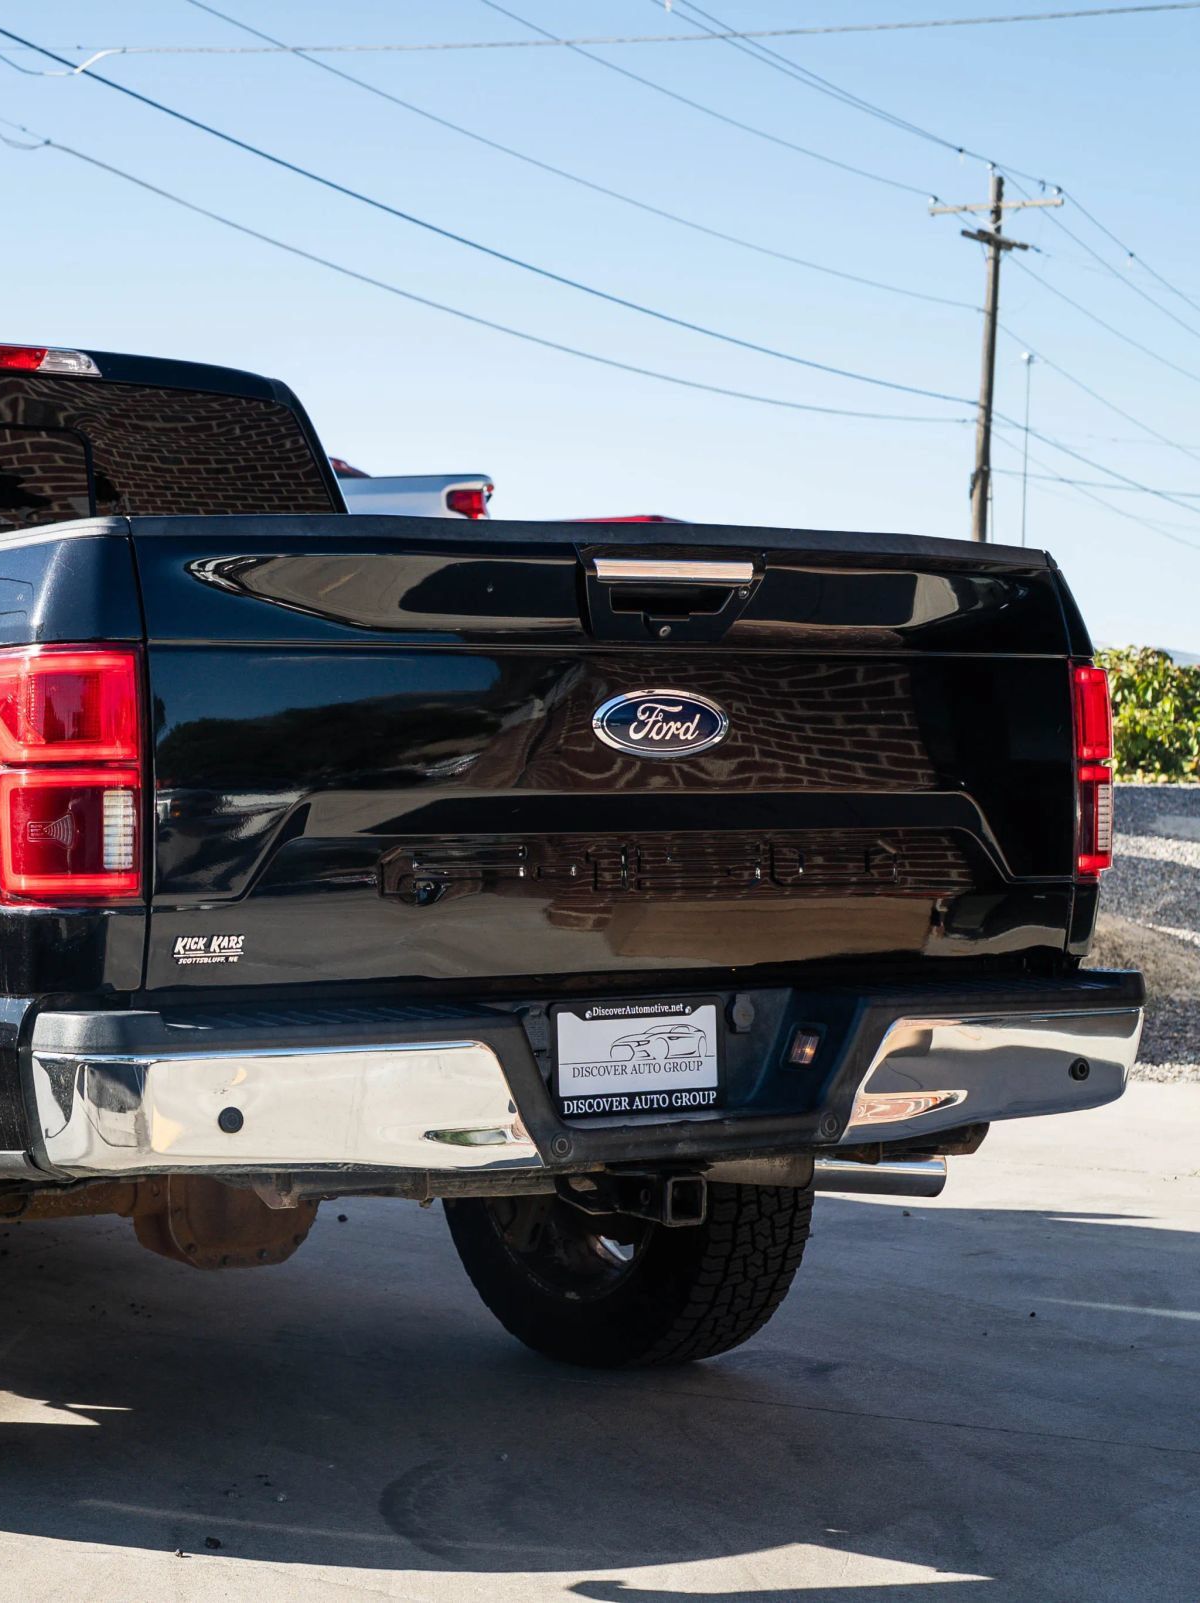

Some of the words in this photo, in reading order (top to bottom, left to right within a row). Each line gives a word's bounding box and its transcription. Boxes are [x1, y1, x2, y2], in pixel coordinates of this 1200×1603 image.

[629, 703, 700, 740] Ford
[174, 937, 207, 955] KICK
[210, 935, 245, 953] KARS
[228, 955, 239, 963] NE
[592, 1003, 684, 1017] DiscoverAutomotive.net
[572, 1064, 628, 1078] DISCOVER
[630, 1062, 662, 1075] AUTO
[664, 1060, 703, 1073] GROUP
[563, 1096, 629, 1114] DISCOVER
[632, 1094, 669, 1109] AUTO
[672, 1090, 717, 1107] GROUP
